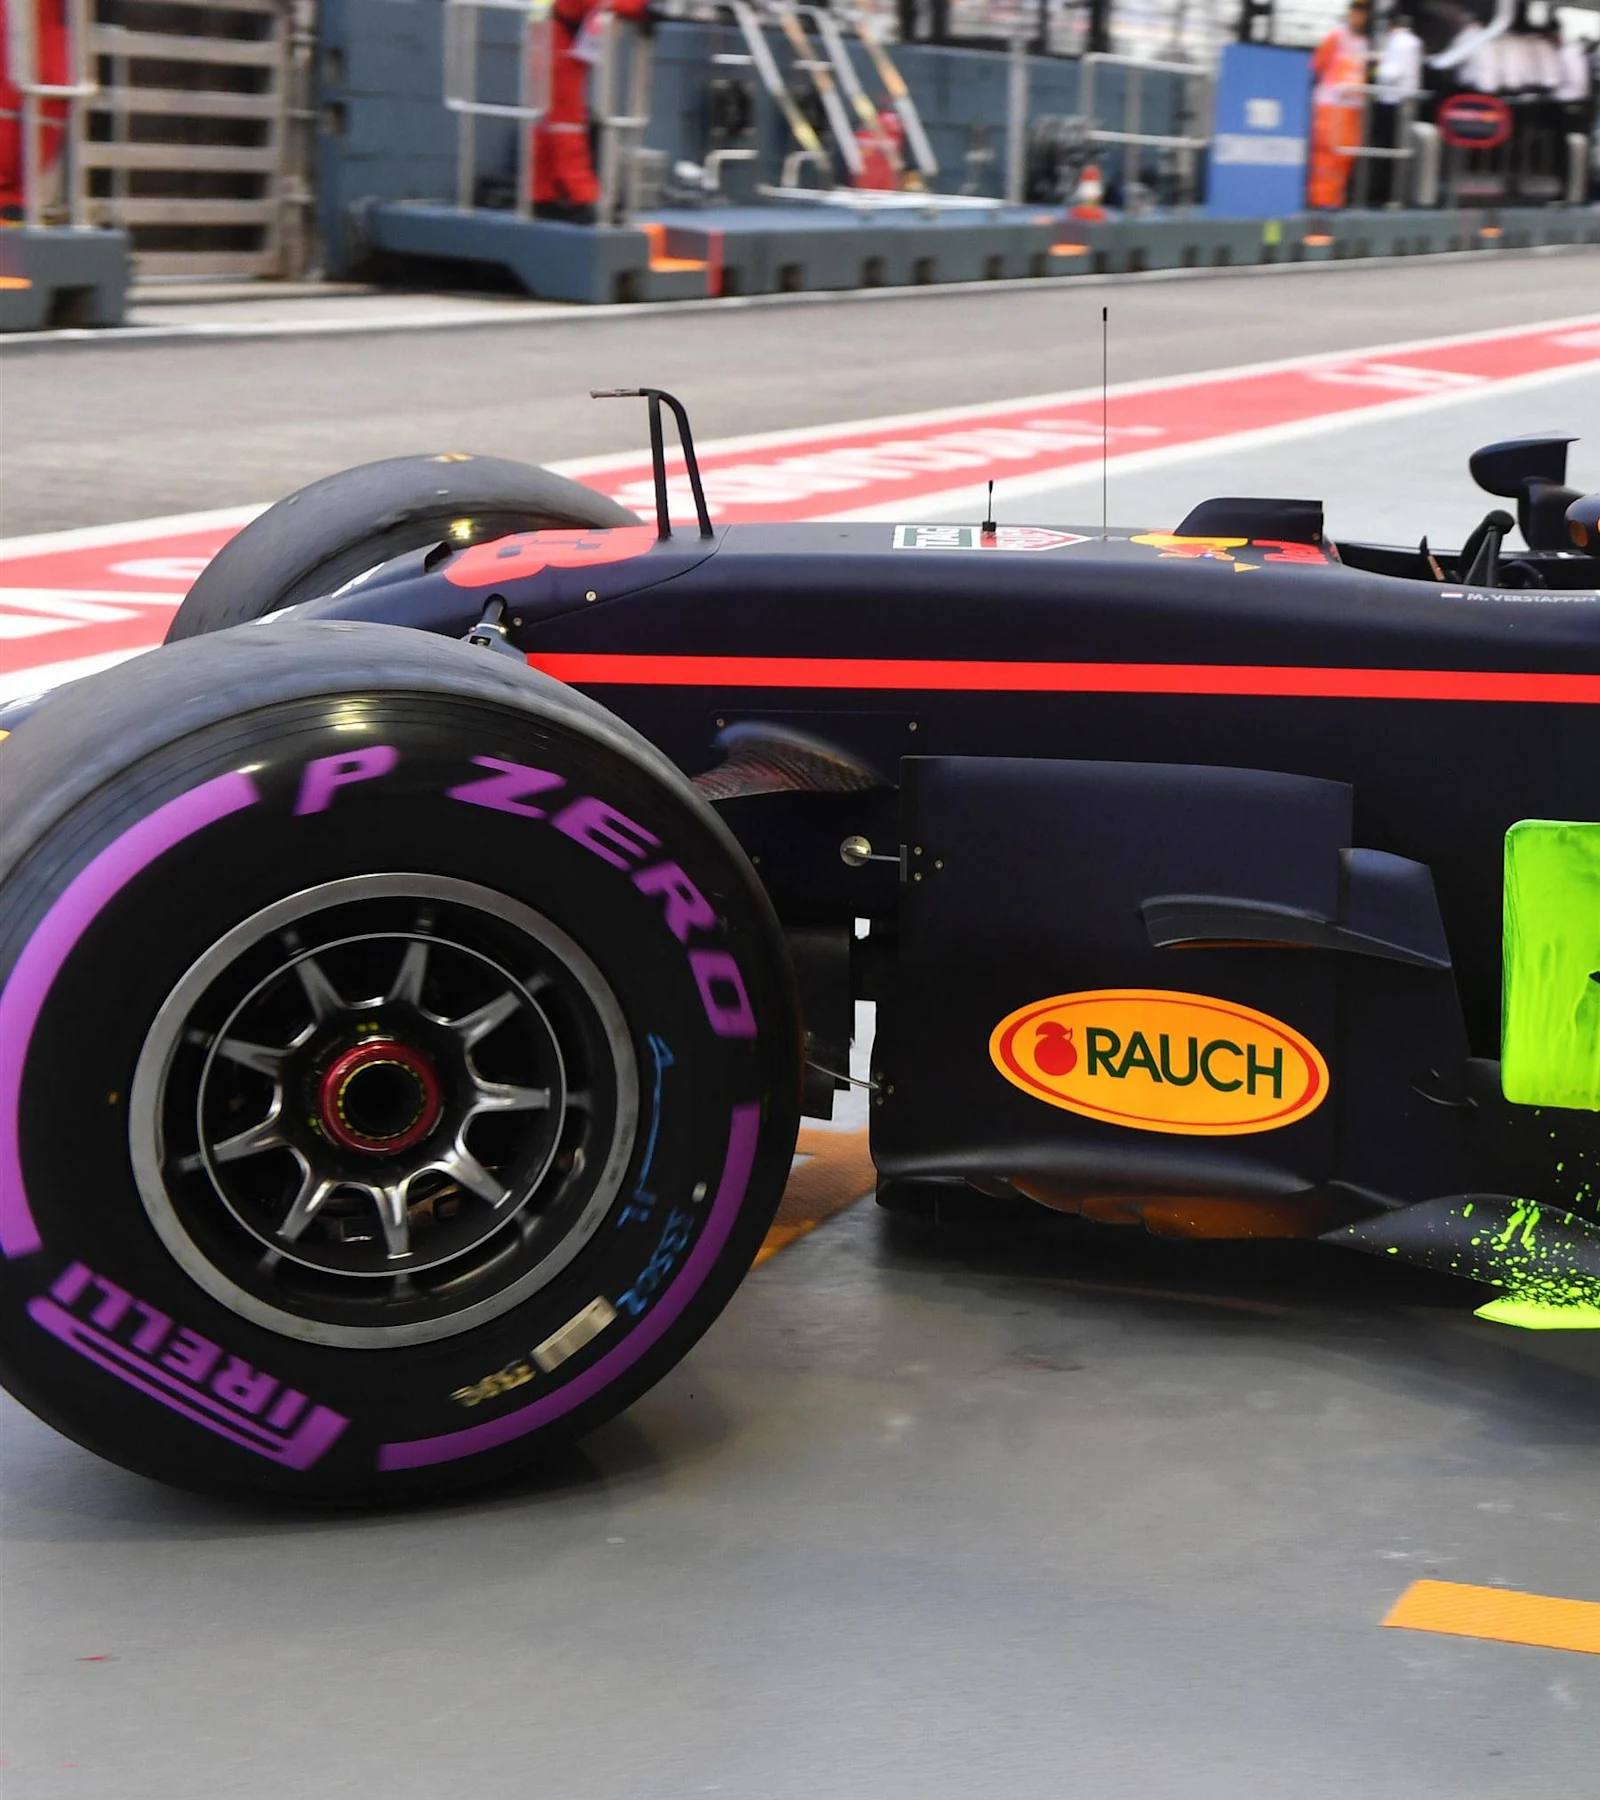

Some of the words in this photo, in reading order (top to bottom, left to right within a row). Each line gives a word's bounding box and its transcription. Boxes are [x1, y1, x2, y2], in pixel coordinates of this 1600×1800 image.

[294, 745, 399, 816] P
[445, 755, 757, 1038] ZERO
[1086, 1026, 1283, 1099] RAUCH
[26, 1260, 349, 1472] PIRELLI
